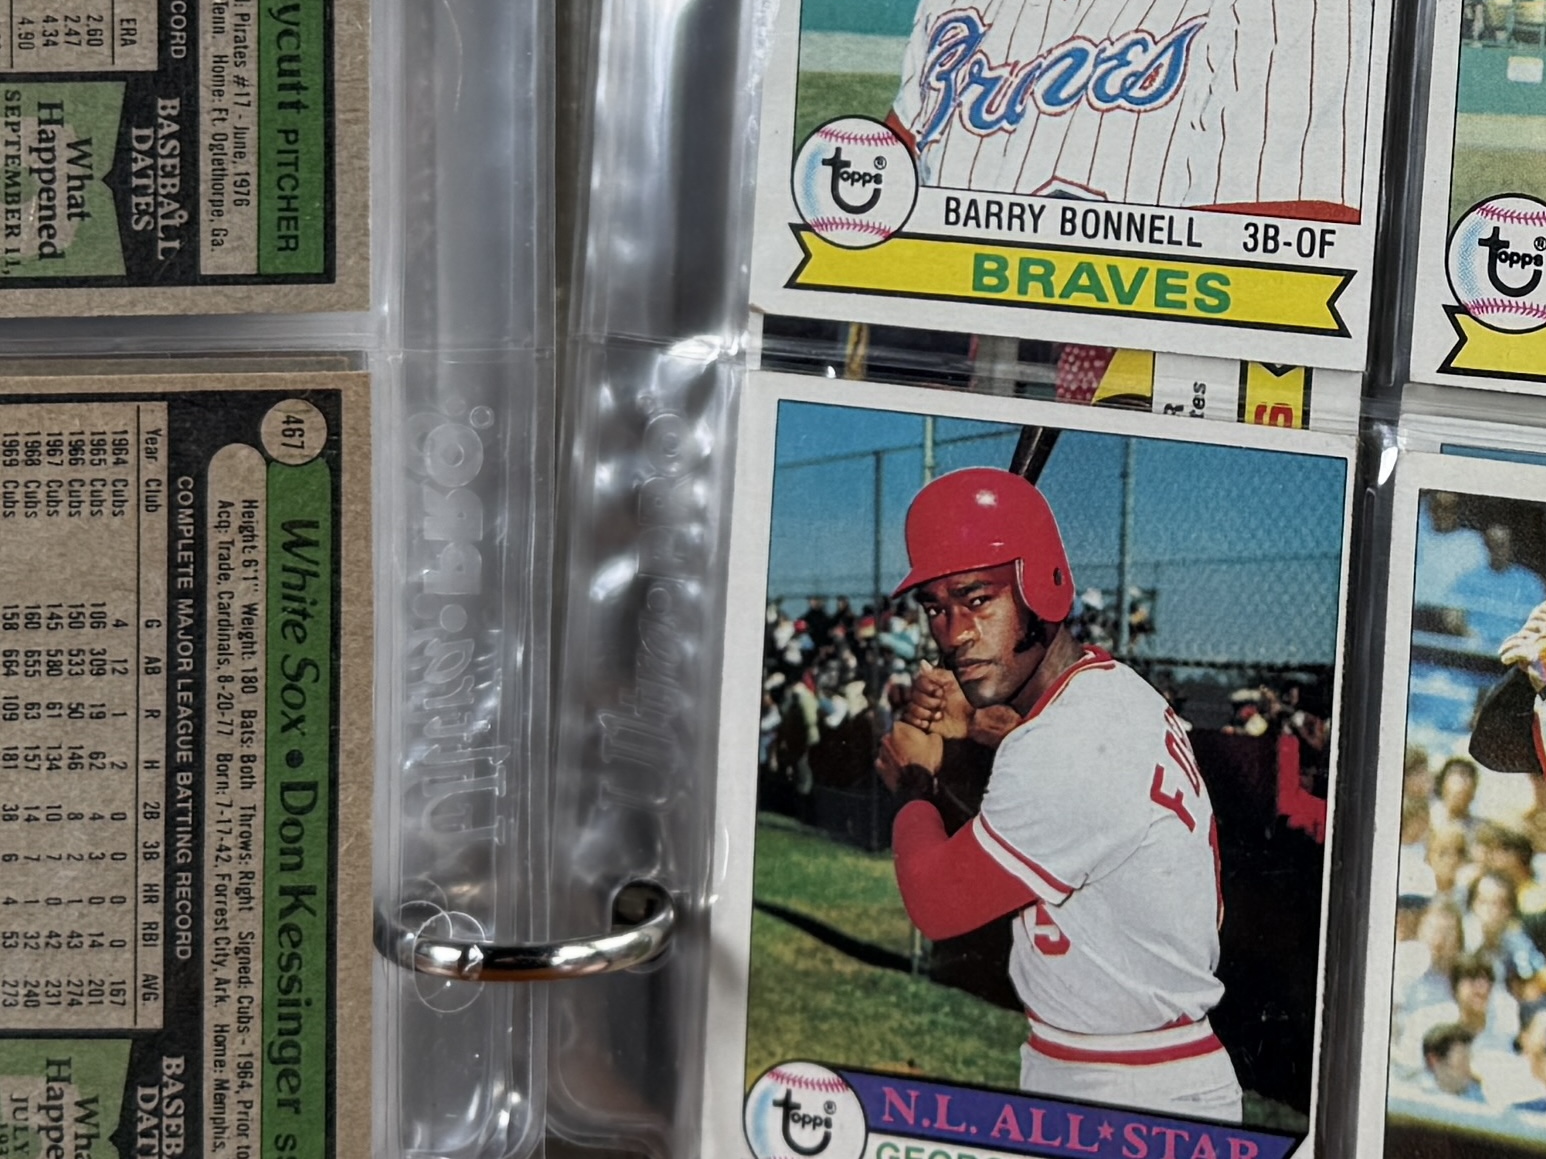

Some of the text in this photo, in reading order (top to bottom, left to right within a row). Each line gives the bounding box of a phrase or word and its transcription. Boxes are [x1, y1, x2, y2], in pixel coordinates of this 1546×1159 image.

[234, 13, 250, 68] Pirates
[212, 55, 228, 102] Home:
[234, 75, 250, 108] #17
[4, 90, 22, 238] SEPTEMBER
[232, 126, 250, 164] June,
[28, 100, 65, 262] Happened
[66, 138, 94, 222] What
[132, 126, 154, 231] DATES
[158, 97, 181, 260] BASEBALL
[208, 133, 228, 222] Oglethorpe,
[234, 172, 250, 207] 1976
[276, 129, 299, 252] PITCHER
[821, 147, 883, 214] topps
[211, 228, 228, 252] Ga.
[944, 197, 1336, 258] BARRY BONNELL 3B-OF
[971, 253, 1232, 313] BRAVES
[1478, 226, 1545, 297] topps
[144, 428, 162, 462] Year
[280, 415, 305, 450] 467
[145, 479, 162, 512] Club
[145, 619, 162, 628] G
[144, 656, 161, 675] AB
[144, 710, 160, 718] R
[175, 476, 194, 960] COMPLETE MAJOR LEAGUE BATTING RECORD
[144, 760, 160, 770] H
[143, 802, 160, 820] 2B
[267, 519, 320, 1114] White Sox Don Kessinger
[143, 841, 160, 860] 3B
[142, 884, 159, 904] HR
[142, 922, 158, 947] RBI
[10, 1094, 28, 1156] JULY
[881, 1087, 978, 1134] N.L.
